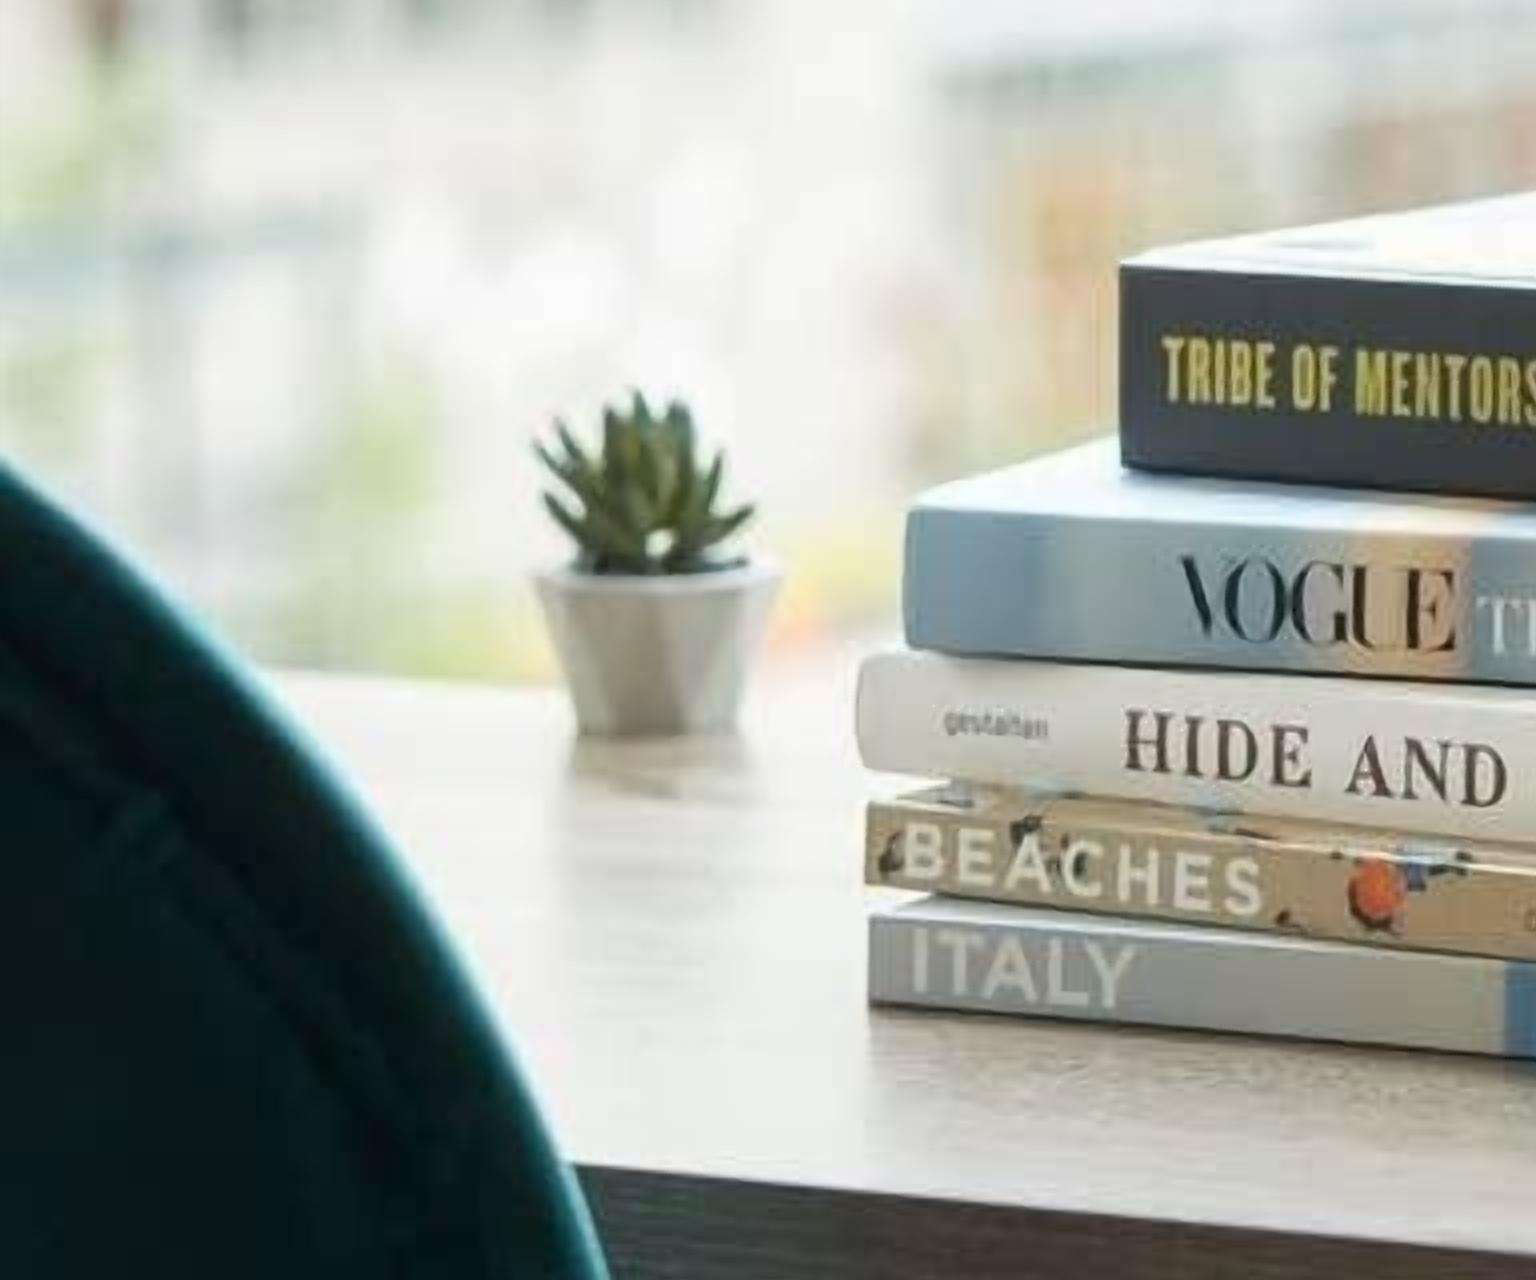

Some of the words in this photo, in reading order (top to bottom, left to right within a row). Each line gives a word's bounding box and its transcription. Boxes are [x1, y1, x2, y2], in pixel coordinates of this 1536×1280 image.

[1162, 336, 1276, 409] TRIBE
[1292, 344, 1339, 412] OF
[1180, 555, 1455, 651] VOGUE
[945, 709, 1049, 741] gestalten
[1124, 709, 1313, 788] HIDE
[1344, 733, 1508, 808] AND
[904, 823, 1263, 917] BEACHES
[911, 928, 1136, 1009] ITALY
